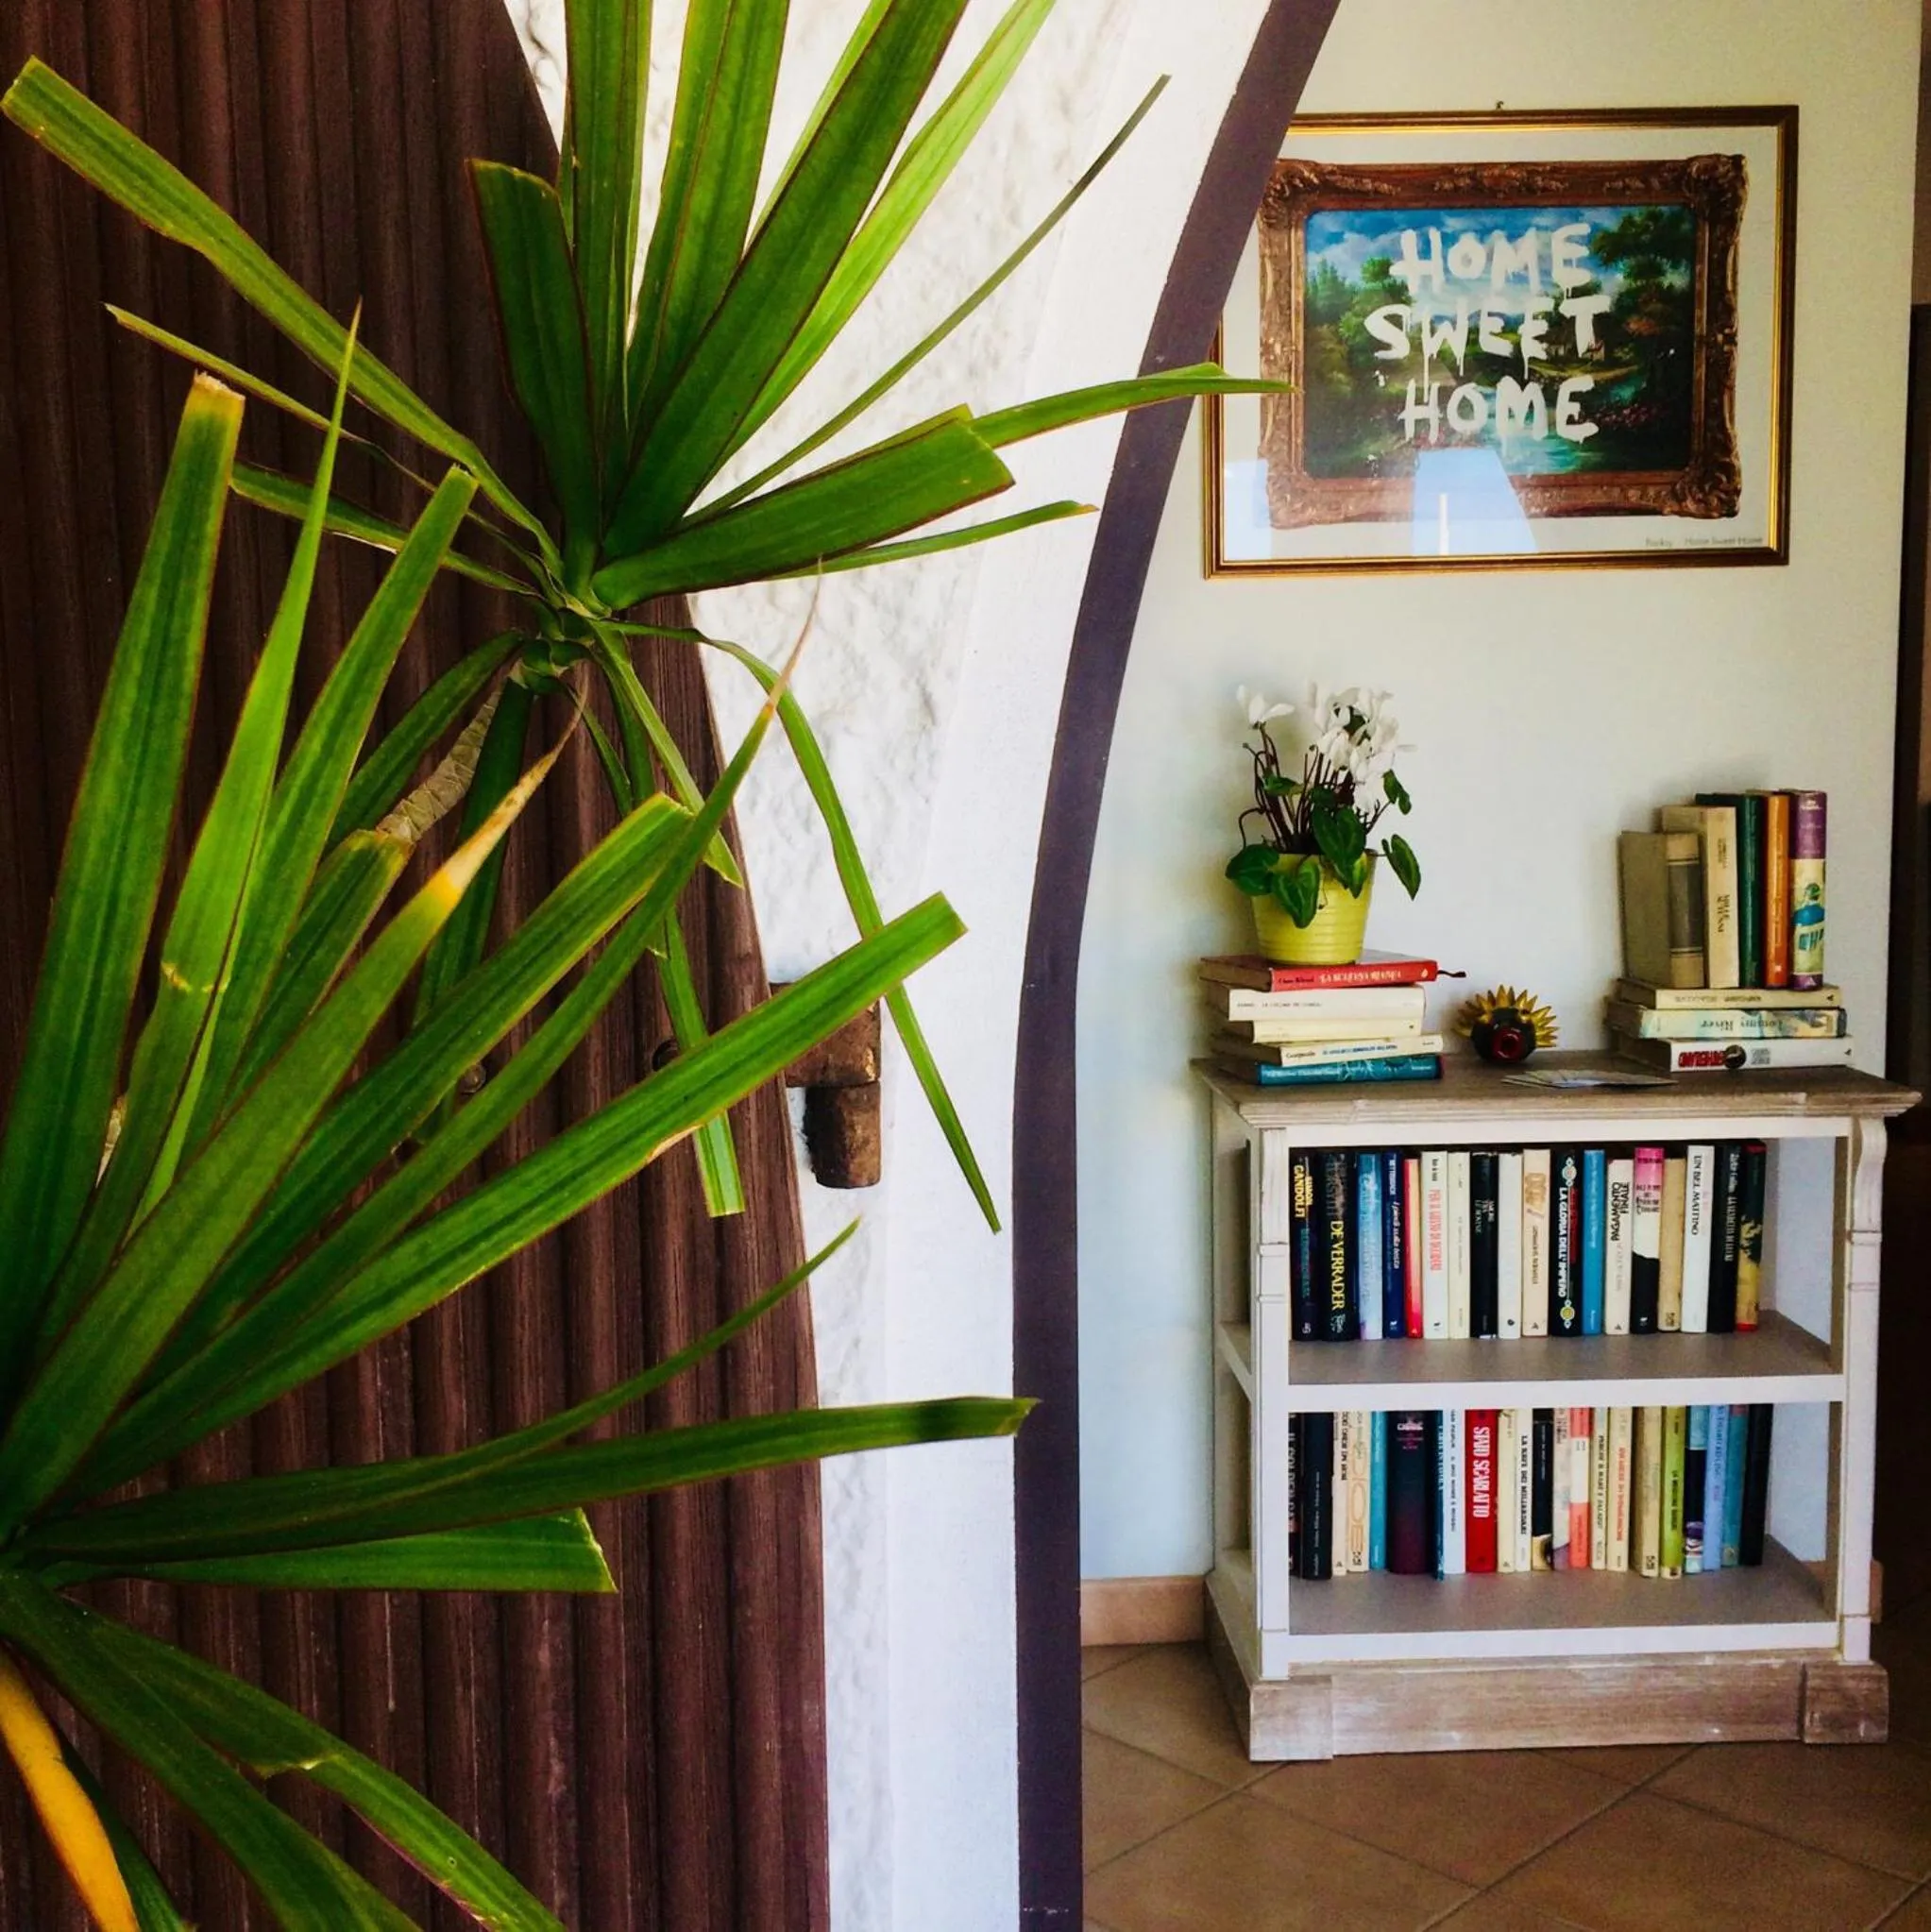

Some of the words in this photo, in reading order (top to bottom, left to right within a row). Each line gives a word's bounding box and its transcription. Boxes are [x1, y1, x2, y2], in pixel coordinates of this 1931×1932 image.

[1389, 224, 1592, 293] HOME
[1364, 294, 1611, 378] SWEET
[1399, 375, 1600, 446] HOME
[1692, 1171, 1702, 1189] BEL
[1693, 1155, 1702, 1168] UN
[1294, 1165, 1305, 1218] GANDOLFI
[1560, 1187, 1567, 1201] LA
[1611, 1182, 1621, 1241] PAGAMENTO
[1619, 1182, 1630, 1214] FINALE
[1691, 1191, 1701, 1235] MATTINO
[1330, 1220, 1345, 1239] DE
[1559, 1202, 1567, 1235] GLORIA
[1331, 1243, 1345, 1311] VERRADER
[1558, 1262, 1567, 1297] IMPERO
[1473, 1460, 1490, 1518] SCARLATTO
